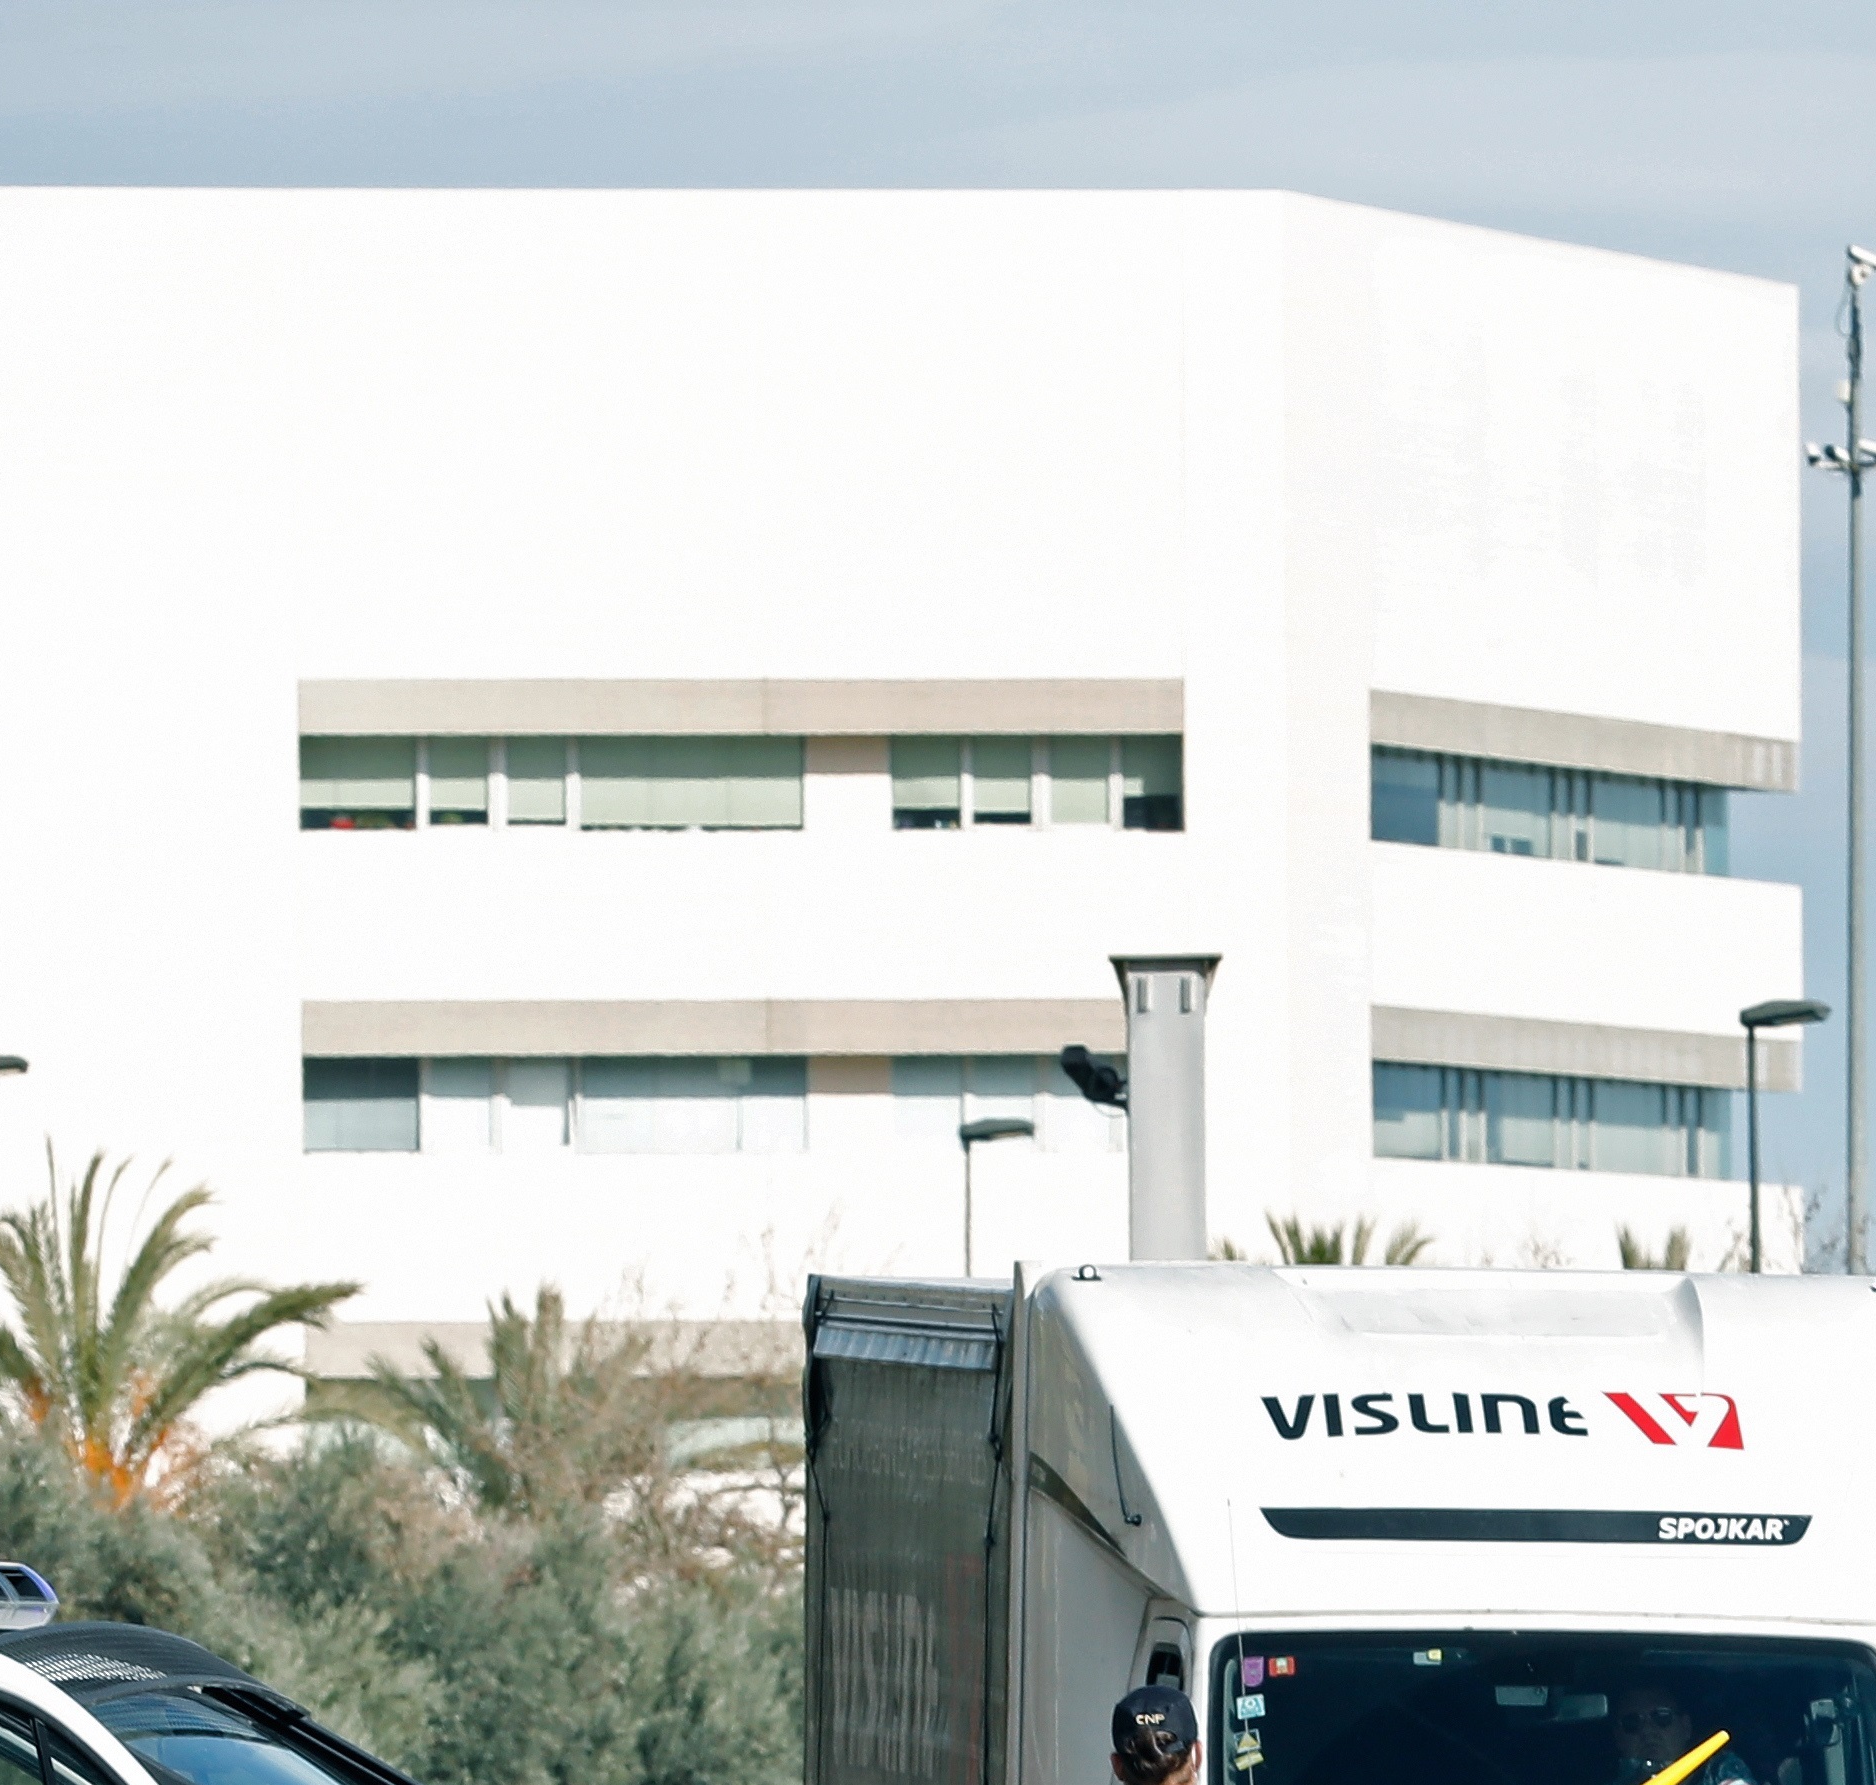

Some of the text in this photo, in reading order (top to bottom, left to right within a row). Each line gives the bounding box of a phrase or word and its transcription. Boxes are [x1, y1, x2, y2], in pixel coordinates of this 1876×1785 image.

[1260, 1391, 1589, 1440] VISLINE
[1658, 1516, 1784, 1541] SPOJKAR
[1135, 1713, 1166, 1726] CNP
